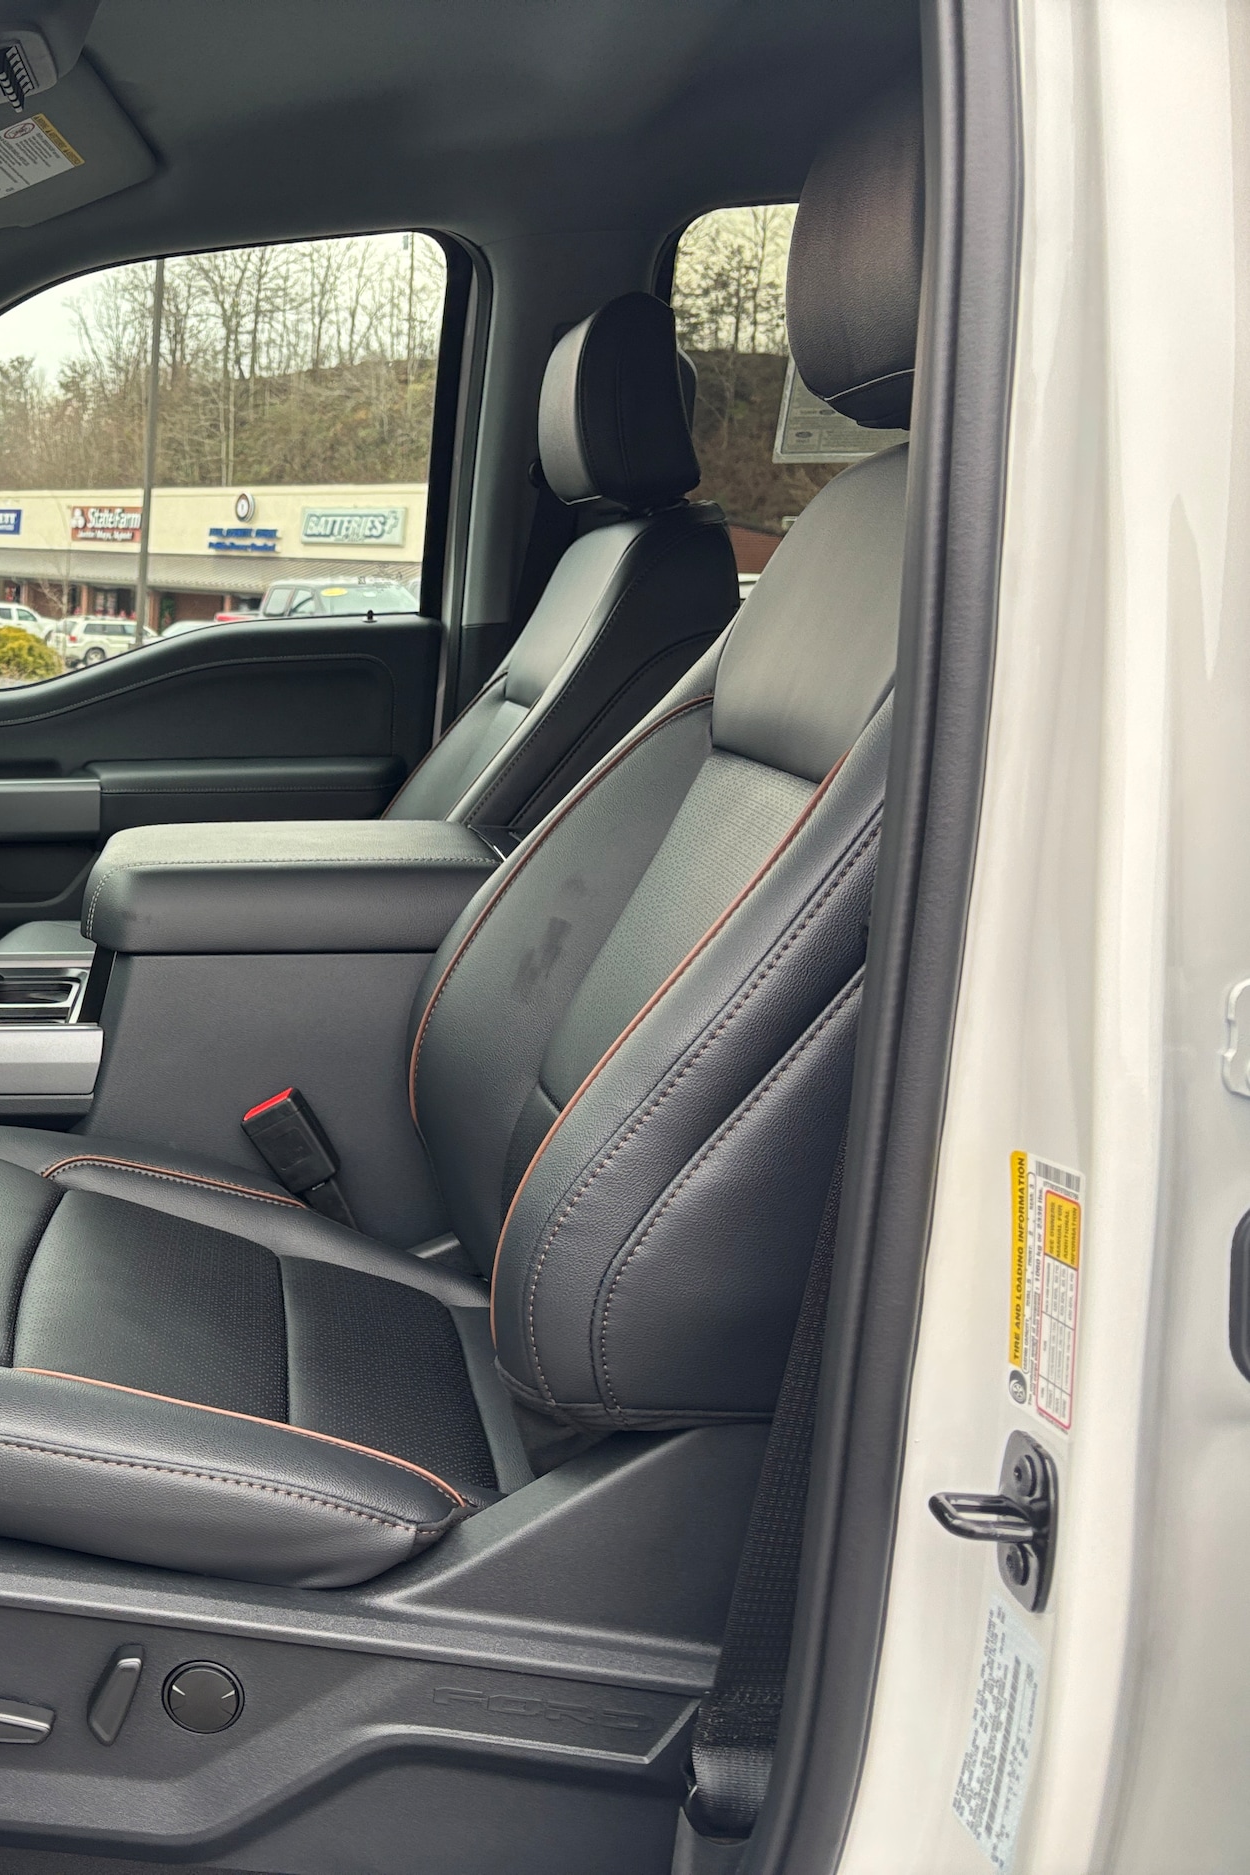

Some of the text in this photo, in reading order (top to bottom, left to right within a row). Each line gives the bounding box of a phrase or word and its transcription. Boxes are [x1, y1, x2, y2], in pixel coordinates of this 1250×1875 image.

[305, 513, 387, 538] BATTERIES
[1017, 1157, 1025, 1243] INFORMATION
[1015, 1246, 1023, 1300] LOADING
[433, 1686, 655, 1731] FORD
